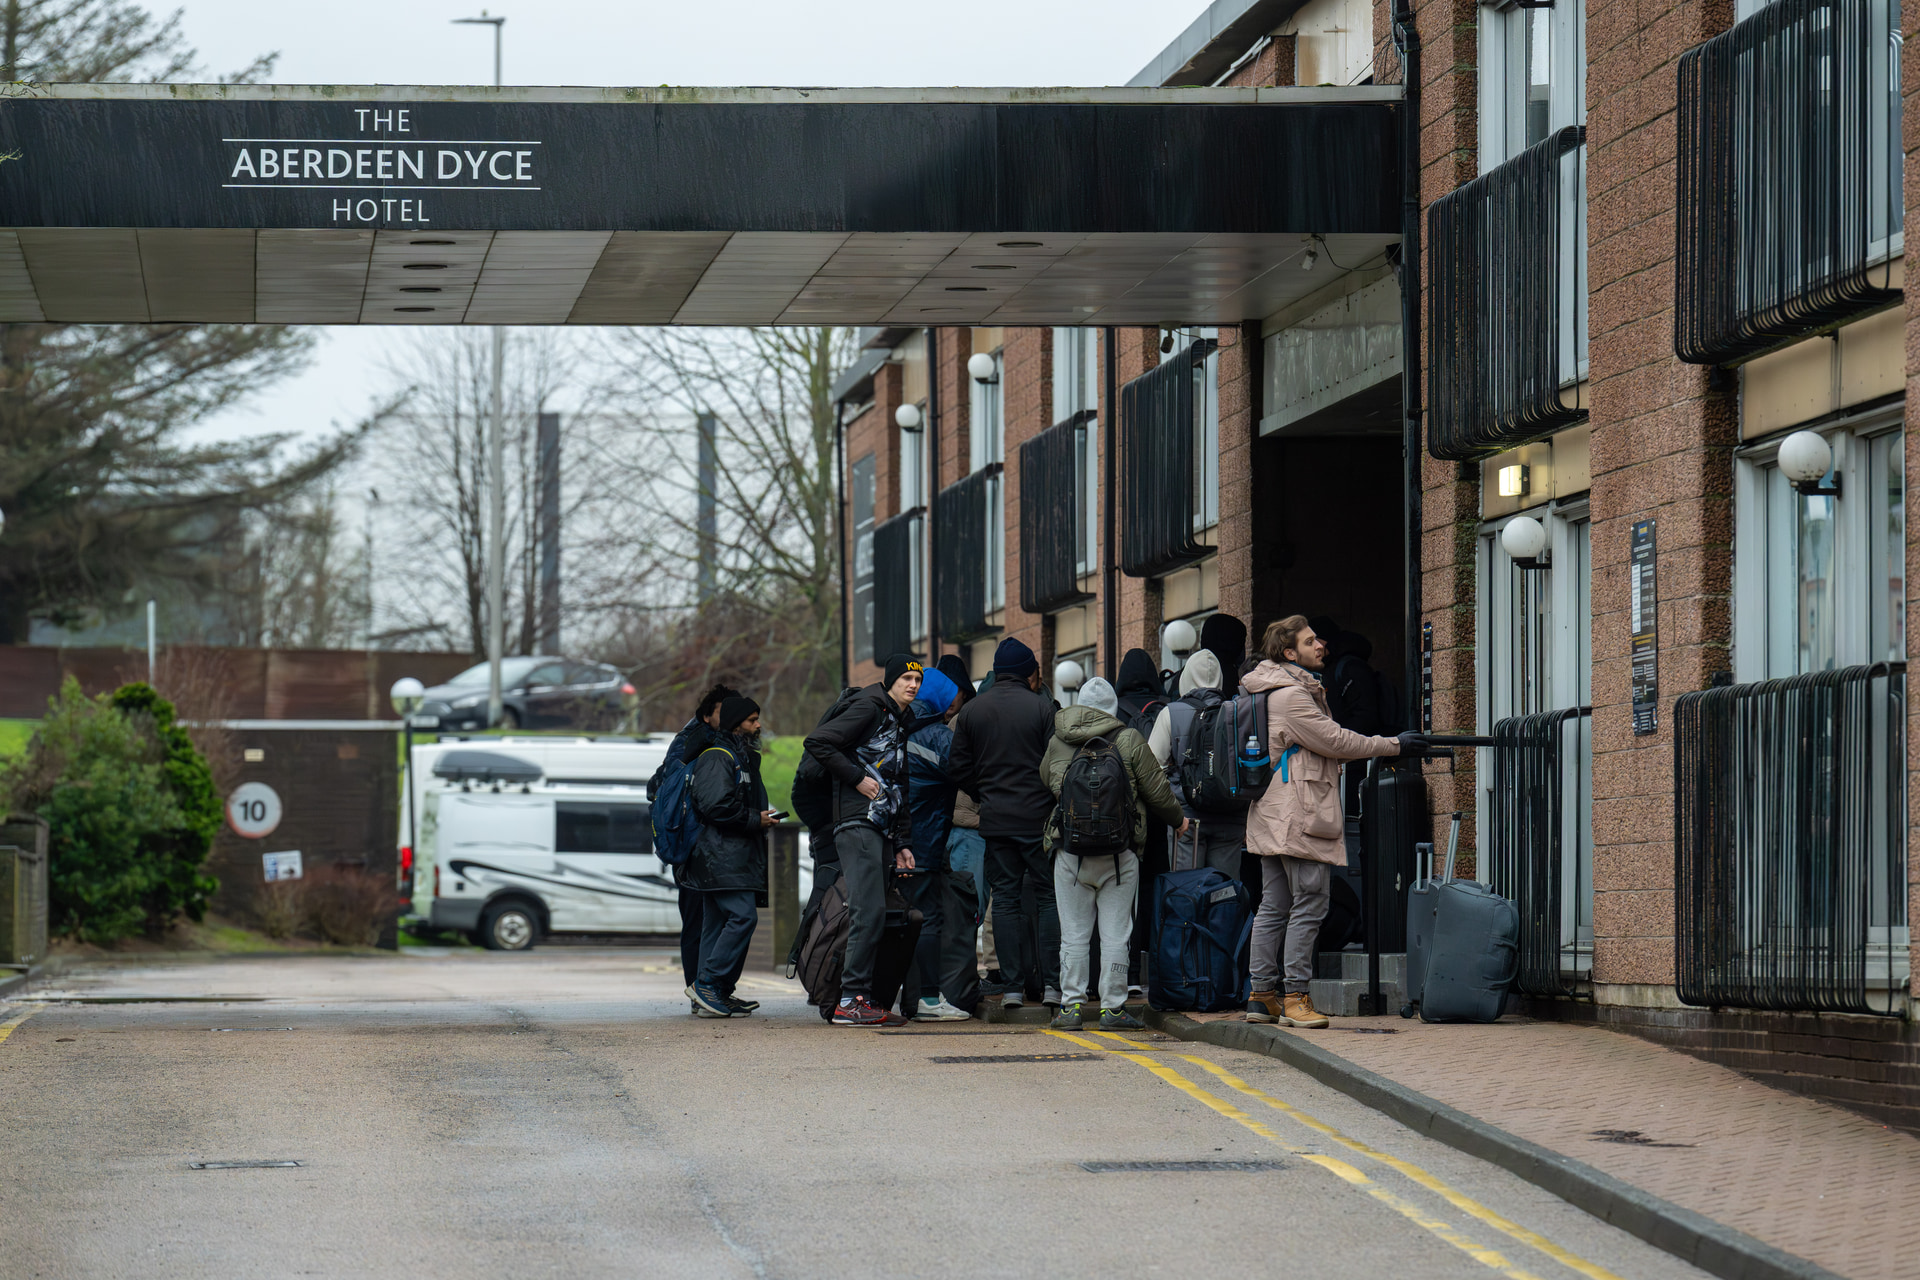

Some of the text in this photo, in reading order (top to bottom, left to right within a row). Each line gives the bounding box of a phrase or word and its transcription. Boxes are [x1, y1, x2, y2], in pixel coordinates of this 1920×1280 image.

[354, 108, 411, 132] THE
[231, 148, 533, 181] ABERDEEN DYCE
[332, 198, 430, 222] HOTEL
[239, 799, 266, 822] 10
